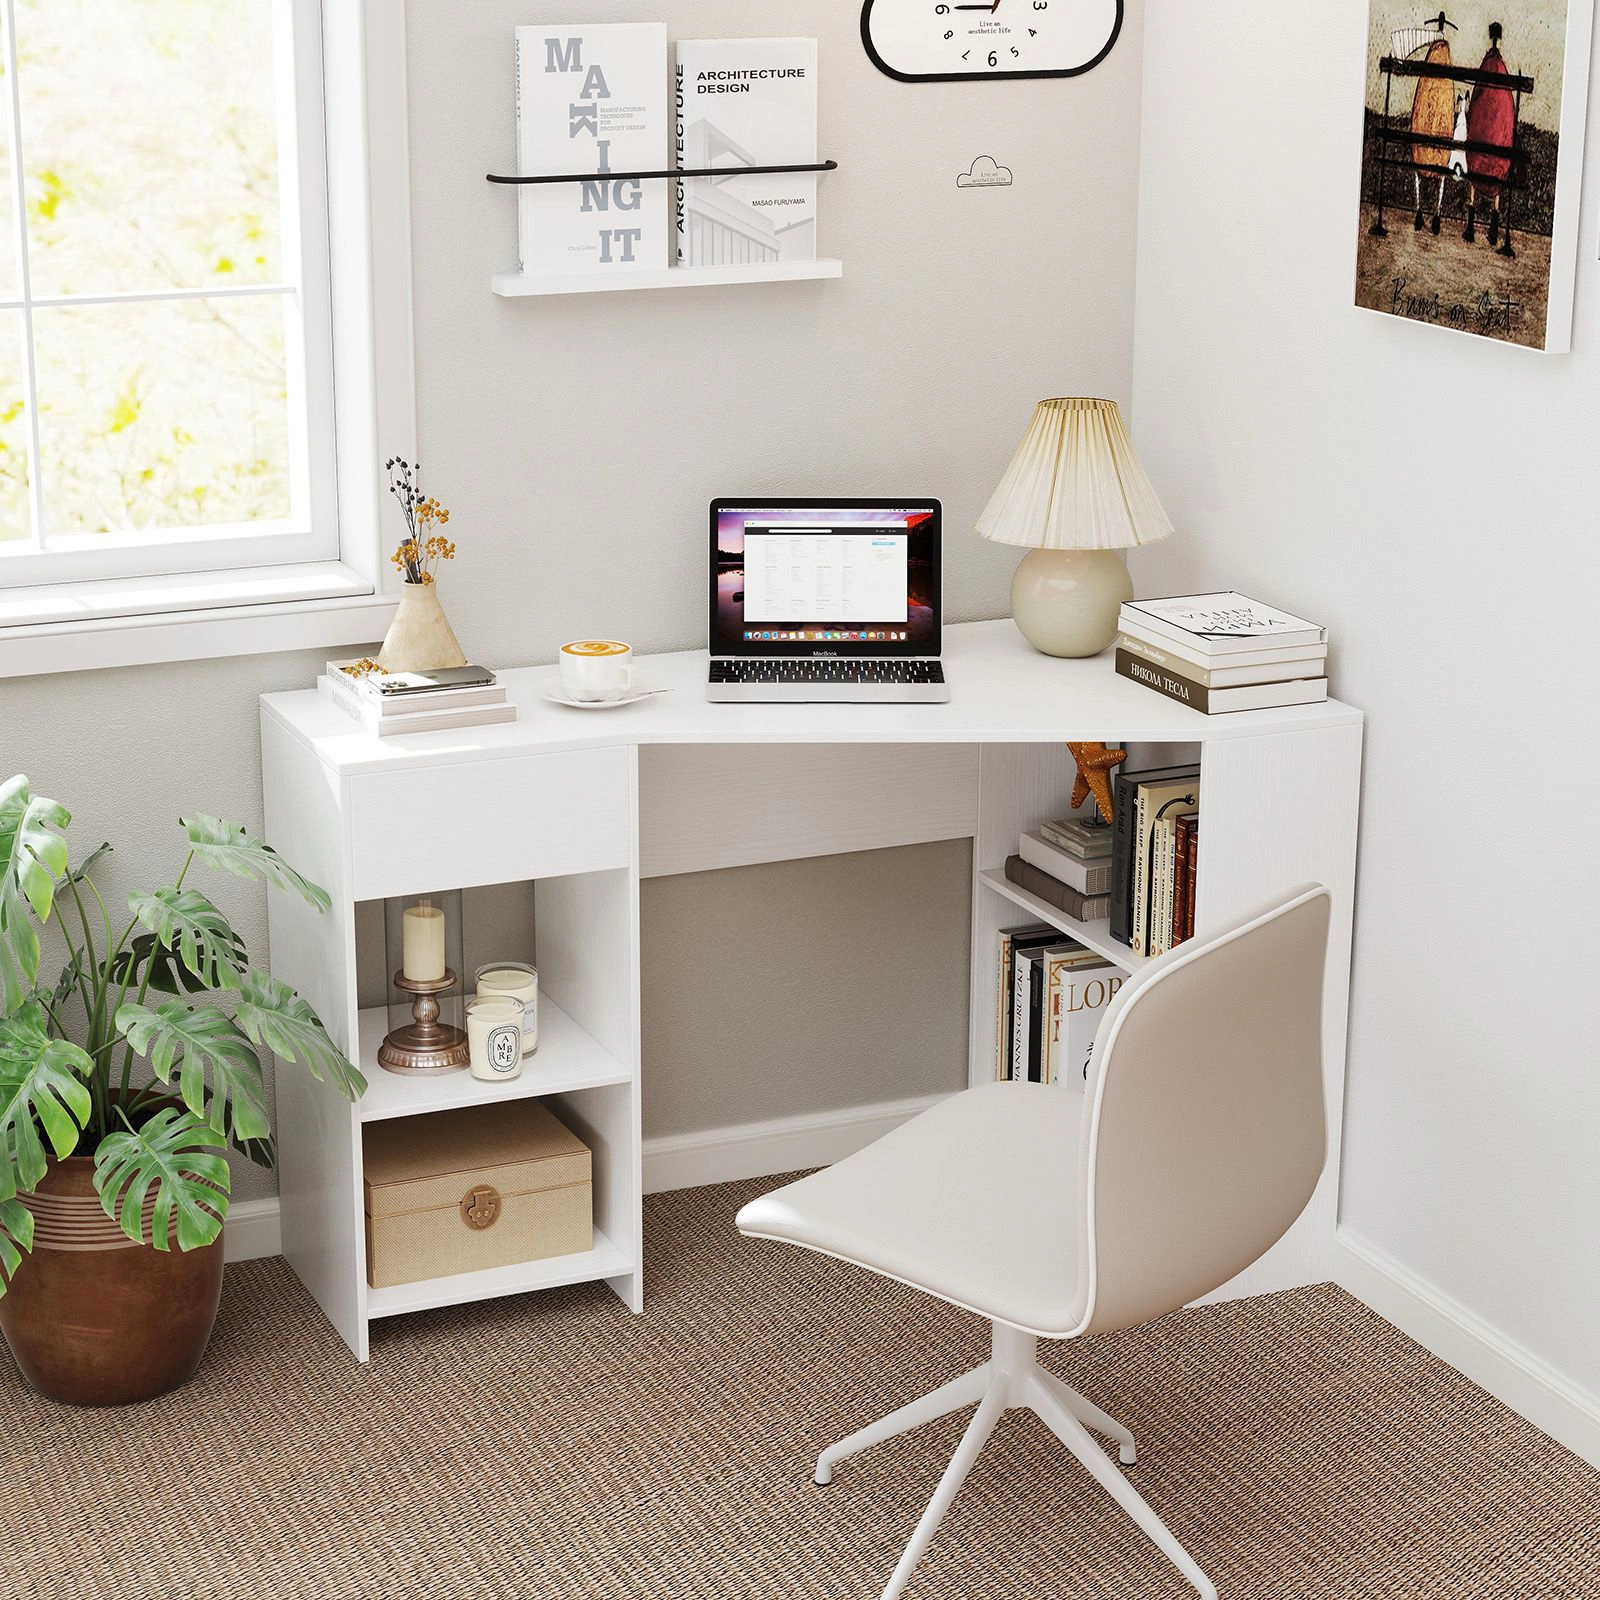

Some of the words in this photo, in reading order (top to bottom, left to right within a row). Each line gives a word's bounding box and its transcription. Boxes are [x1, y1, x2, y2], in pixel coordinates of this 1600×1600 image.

[1033, 0, 1048, 11] 3
[943, 30, 954, 40] 8
[1028, 28, 1038, 38] 4
[987, 50, 998, 67] 6
[1010, 46, 1020, 58] 5
[697, 68, 806, 81] ARCHITECTURE
[697, 83, 750, 94] DESIGN
[675, 63, 685, 234] ARCHITECTURE
[752, 199, 773, 207] MASAO
[774, 198, 806, 206] FURUYAMA
[1130, 662, 1162, 688] НИКОЛА
[1163, 676, 1190, 701] ТЕСЛА
[1118, 786, 1127, 809] Ron
[1117, 810, 1127, 834] Arad
[1067, 974, 1132, 1013] LOR
